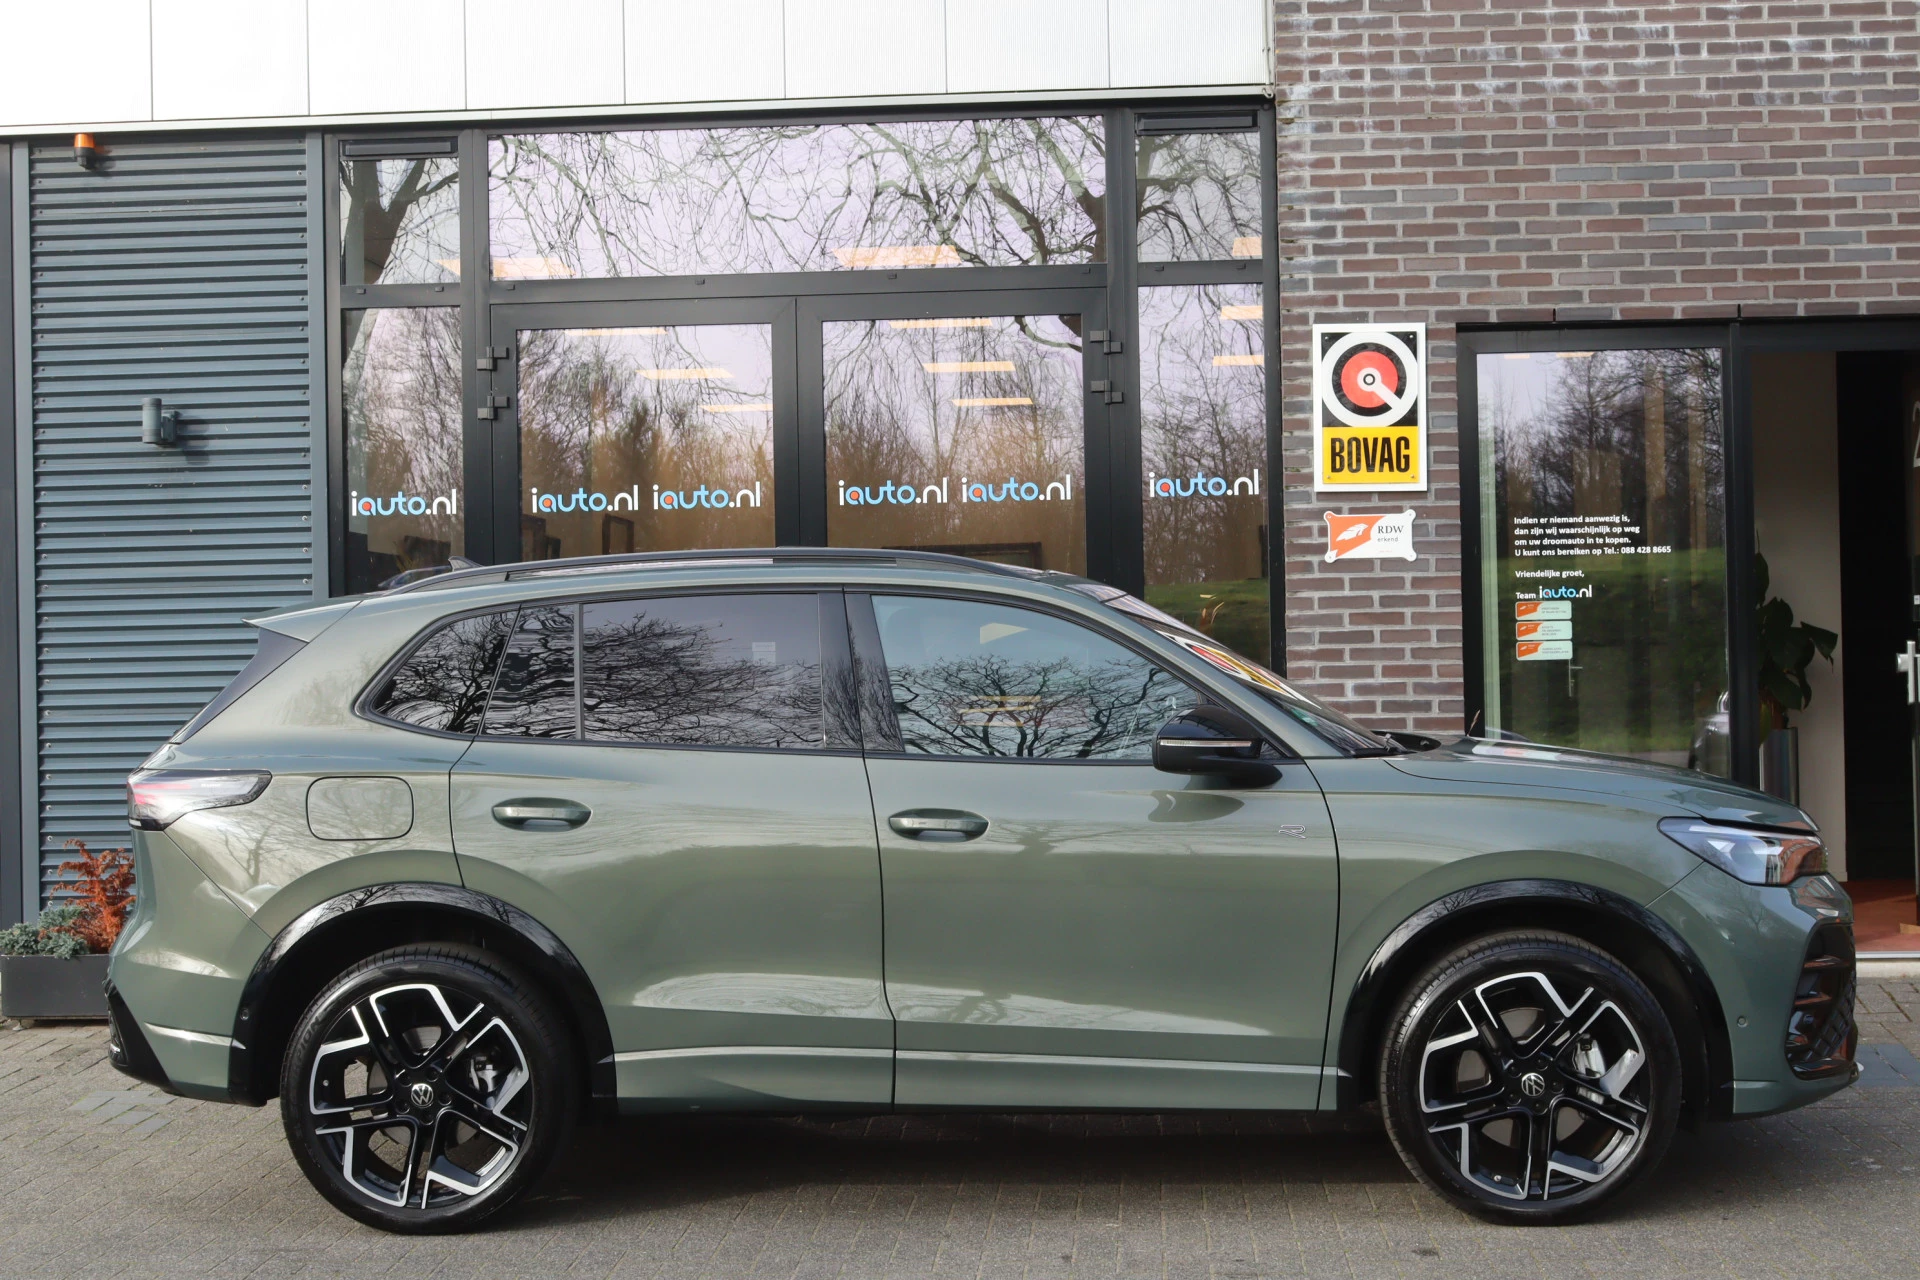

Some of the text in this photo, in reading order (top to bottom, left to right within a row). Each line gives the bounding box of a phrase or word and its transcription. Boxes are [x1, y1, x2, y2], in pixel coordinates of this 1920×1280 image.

[1330, 436, 1410, 473] BOVAG
[839, 473, 1071, 506] iauto.nl iauto.nl
[1149, 468, 1259, 498] iauto.nl
[351, 488, 457, 517] iauto.nl
[531, 481, 761, 514] iauto.nl iauto.nl
[1584, 514, 1620, 523] aanwezig
[1621, 514, 1631, 523] is,
[1377, 525, 1404, 534] RDW
[1514, 525, 1640, 536] dan zijn wij waarschijnlijk op weg
[1542, 537, 1585, 545] droomauto
[1586, 536, 1594, 544] in
[1605, 536, 1632, 545] kopen.
[1522, 548, 1541, 556] kunt
[1556, 547, 1590, 556] bereiken
[1591, 548, 1602, 556] op
[1603, 546, 1619, 555] Tel.:
[1620, 546, 1635, 554] 088
[1636, 546, 1651, 554] 428
[1652, 545, 1672, 553] 8665
[1515, 569, 1585, 579] Vriendelijke groet,
[1515, 584, 1593, 599] Team iauto.nl
